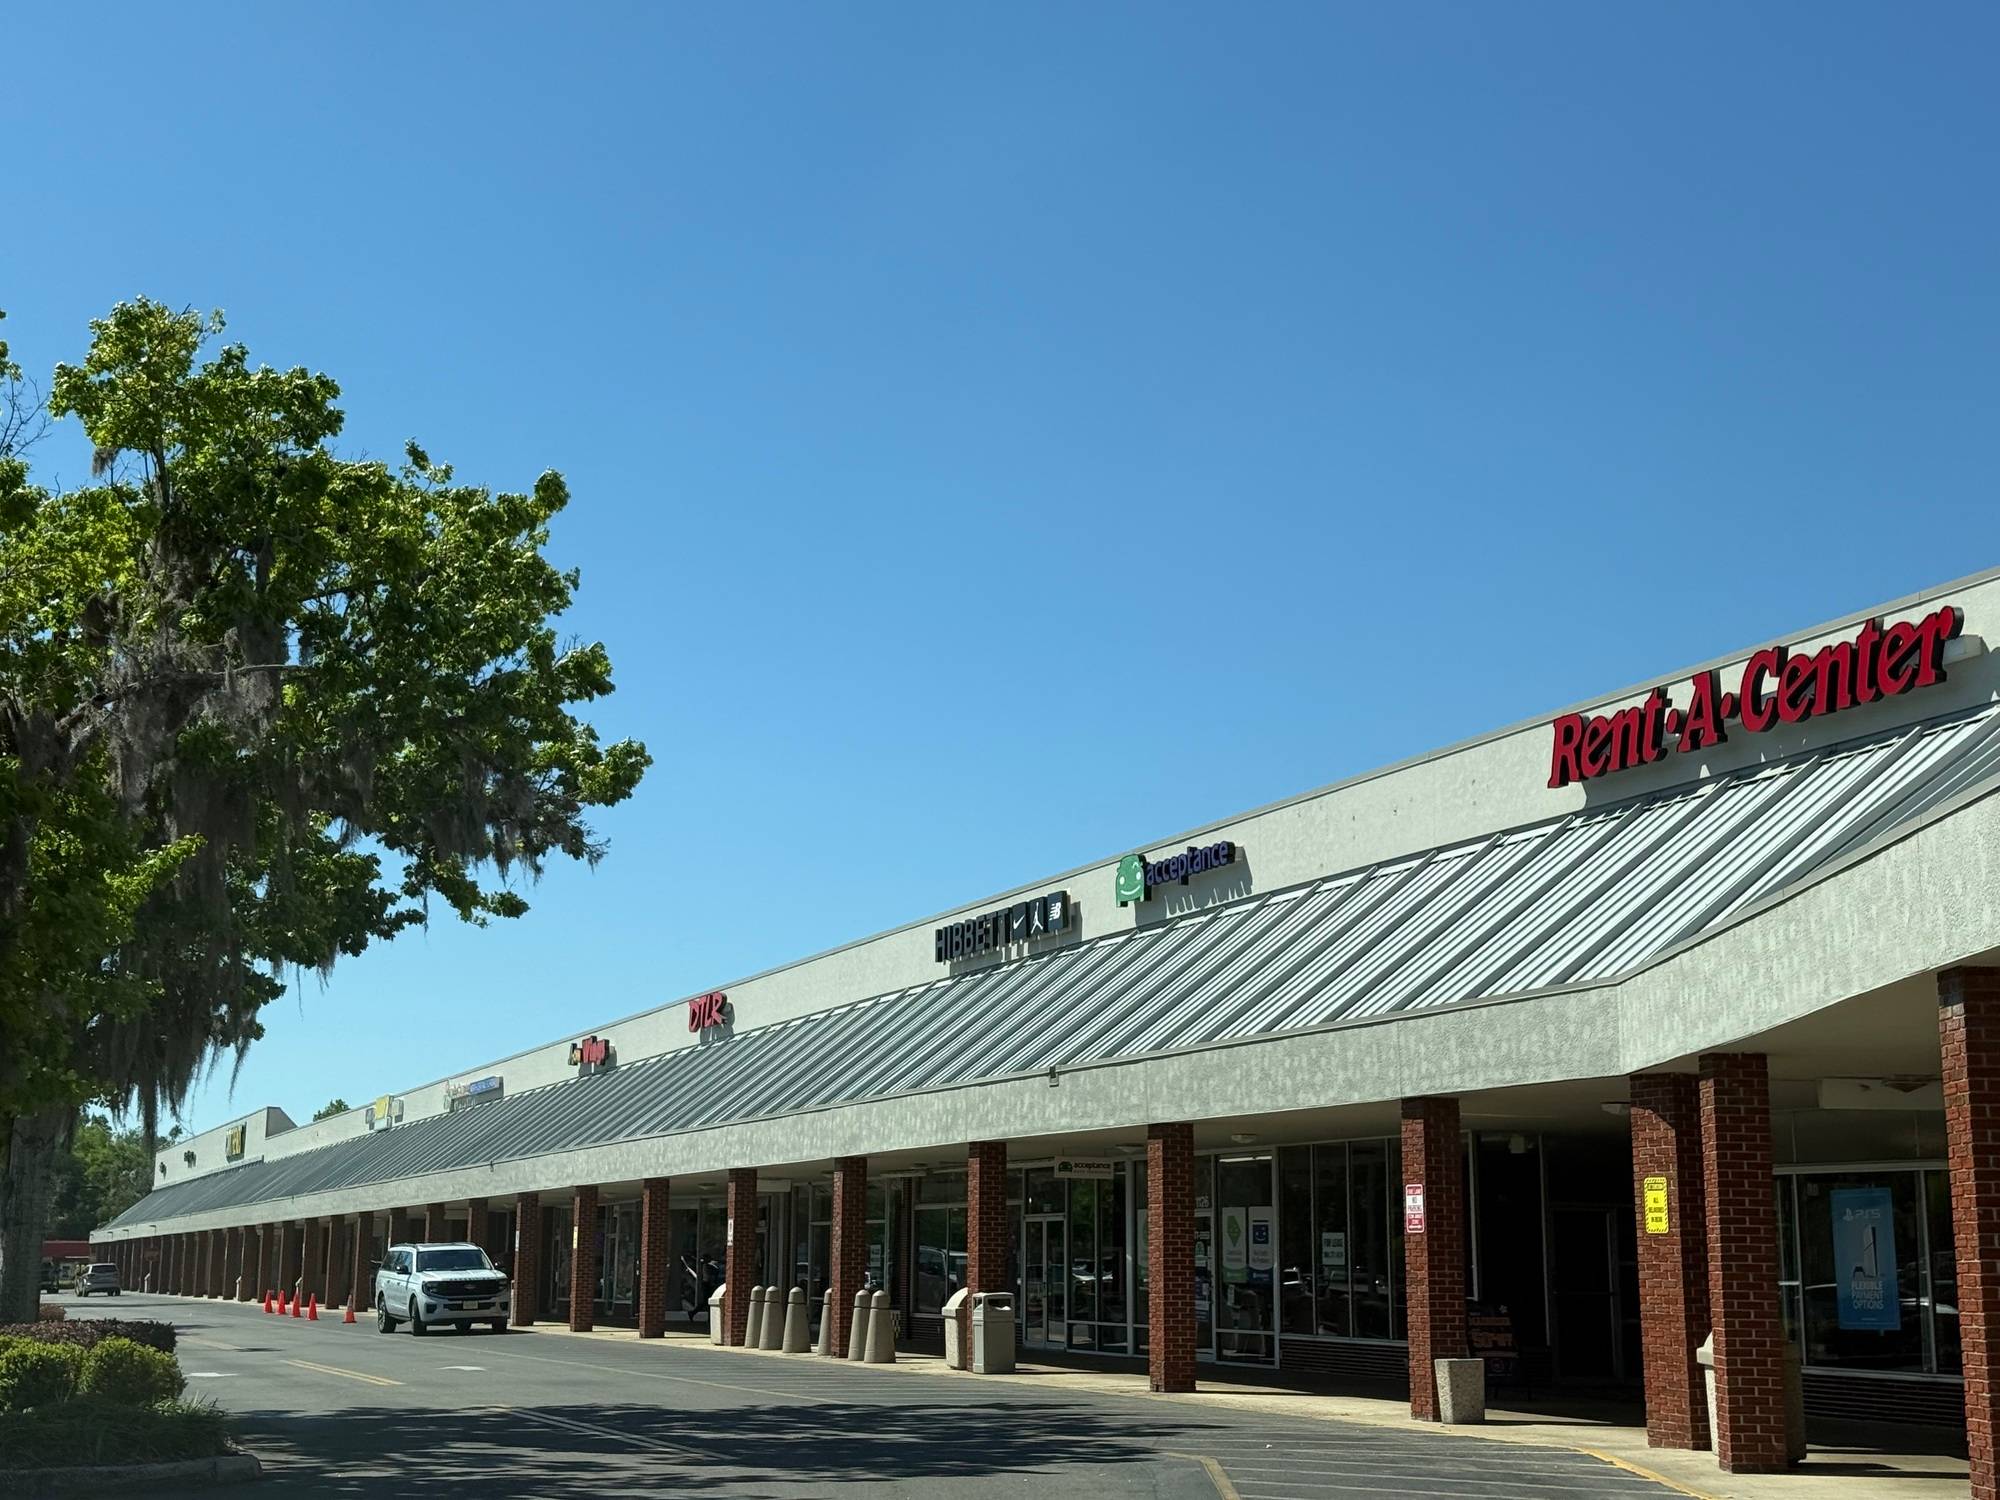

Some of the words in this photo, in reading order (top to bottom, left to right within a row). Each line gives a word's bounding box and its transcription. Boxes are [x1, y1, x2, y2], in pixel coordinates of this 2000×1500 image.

[1146, 841, 1236, 886] acceptance
[935, 907, 1012, 963] HIBBETT
[688, 991, 728, 1033] DTLR
[1855, 1208, 1881, 1219] PS5
[1853, 1300, 1884, 1310] OPTIONS
